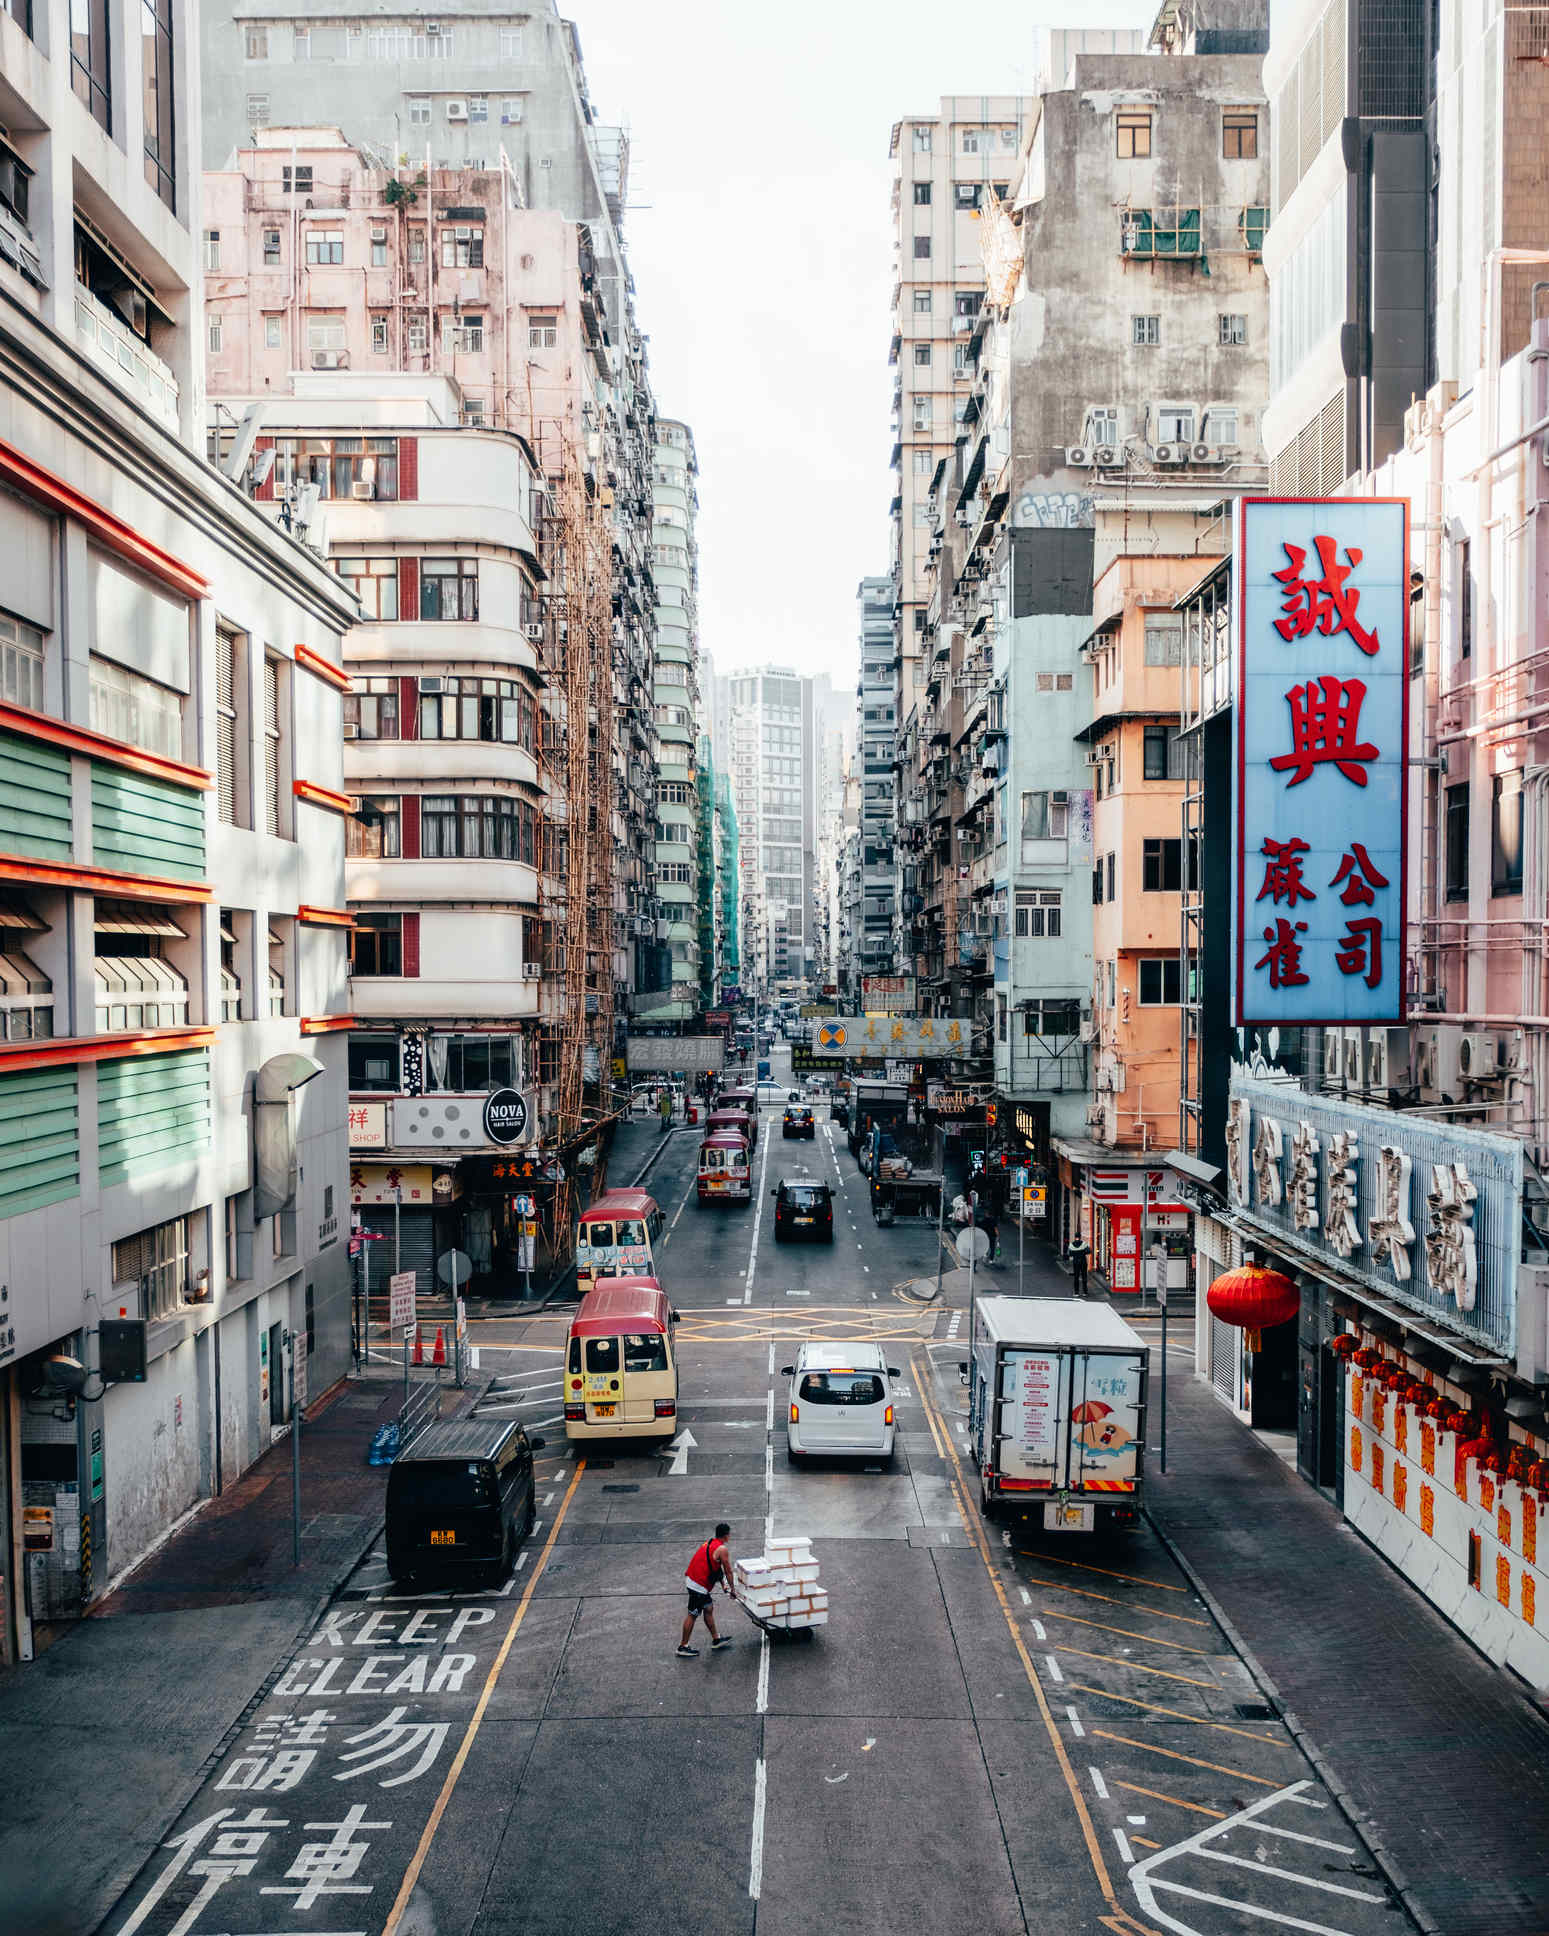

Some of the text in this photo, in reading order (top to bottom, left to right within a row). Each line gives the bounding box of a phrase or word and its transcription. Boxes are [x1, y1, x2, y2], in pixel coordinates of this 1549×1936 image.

[1329, 842, 1389, 988] 公司
[490, 1105, 524, 1119] NOVA
[352, 1134, 381, 1144] SHOP
[309, 1608, 496, 1646] KEEP
[272, 1653, 478, 1696] CLEAR
[214, 1707, 451, 1793] 請勿
[114, 1804, 393, 1936] 停車
